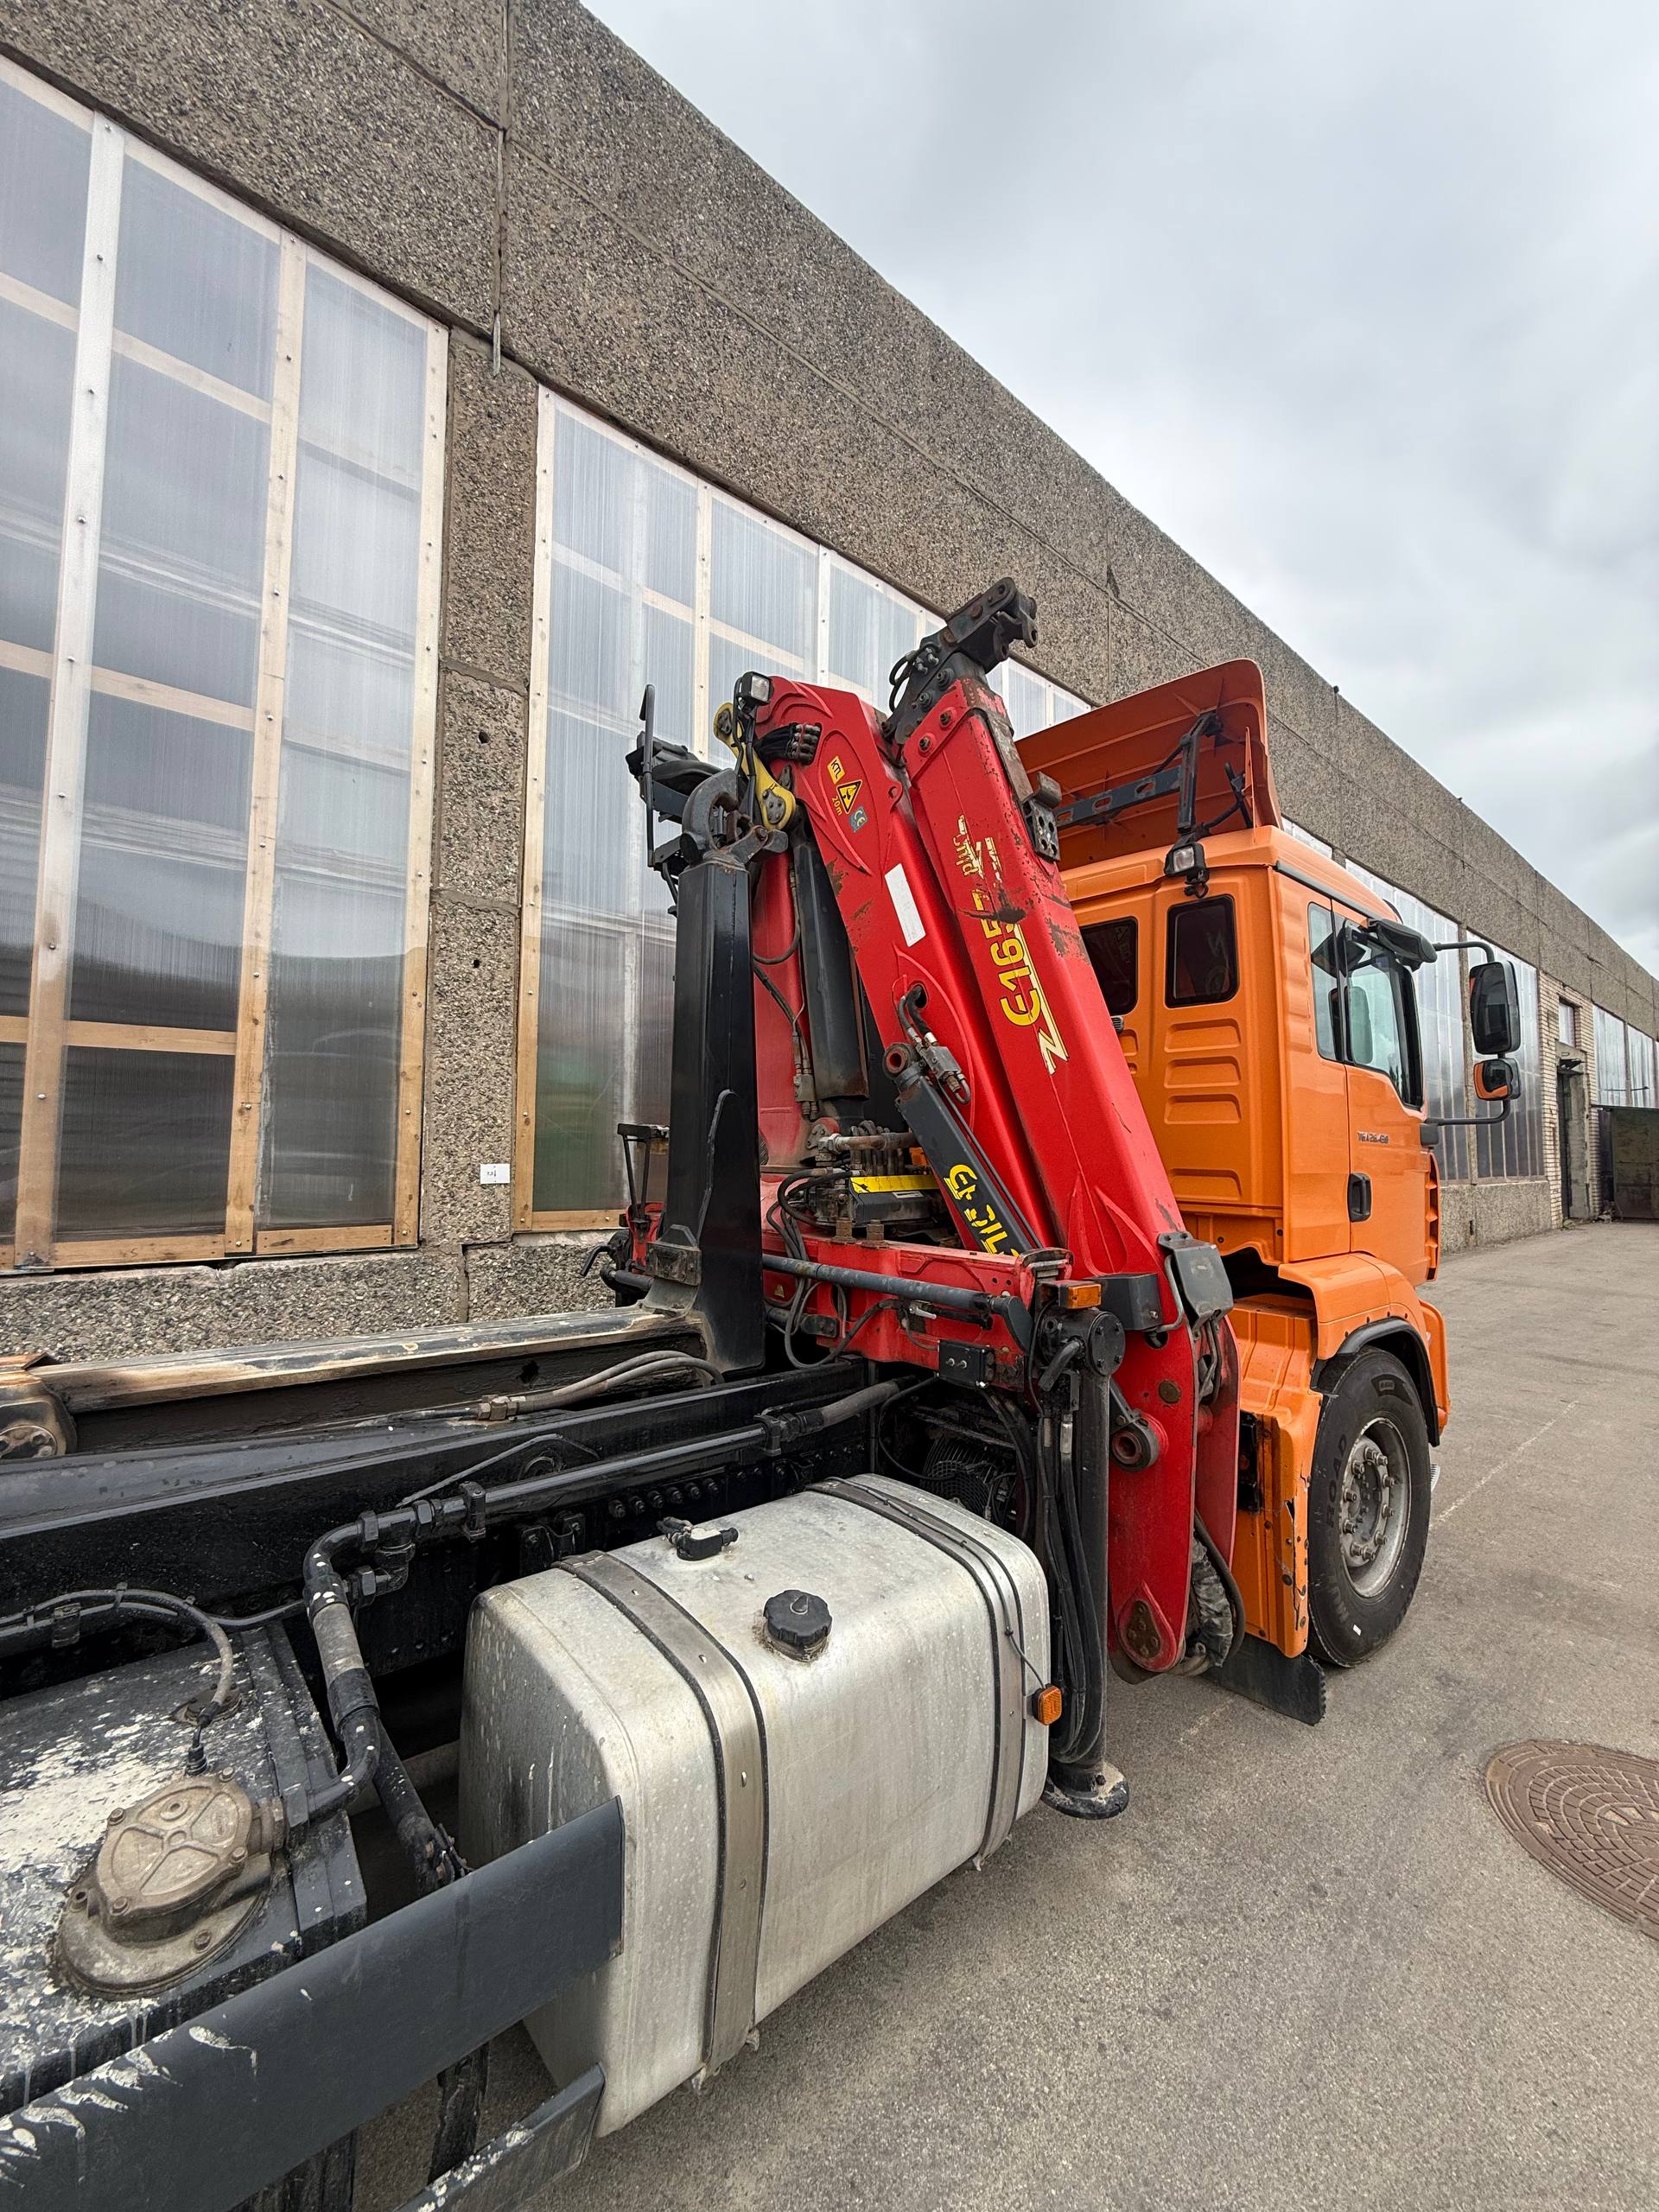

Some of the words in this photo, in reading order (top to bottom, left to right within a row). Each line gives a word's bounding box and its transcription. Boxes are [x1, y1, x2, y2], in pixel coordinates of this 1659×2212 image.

[831, 795, 843, 817] 20m
[854, 810, 866, 827] CE
[953, 834, 978, 877] plu
